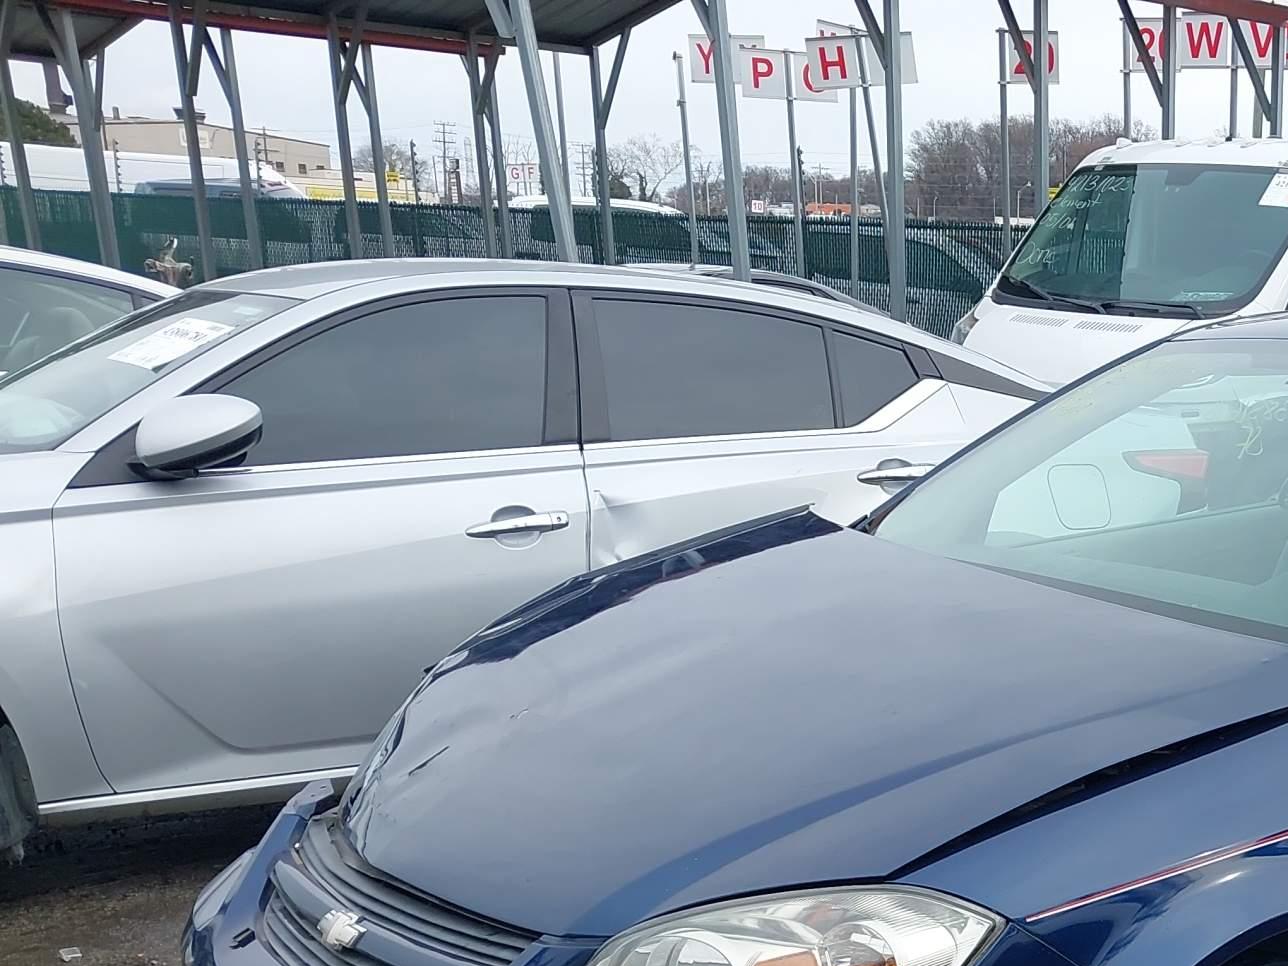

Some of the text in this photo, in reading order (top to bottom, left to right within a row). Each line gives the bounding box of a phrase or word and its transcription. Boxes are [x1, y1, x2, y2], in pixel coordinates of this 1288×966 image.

[1186, 21, 1224, 59] W
[752, 57, 774, 88] P
[818, 45, 848, 80] H
[511, 167, 520, 180] G
